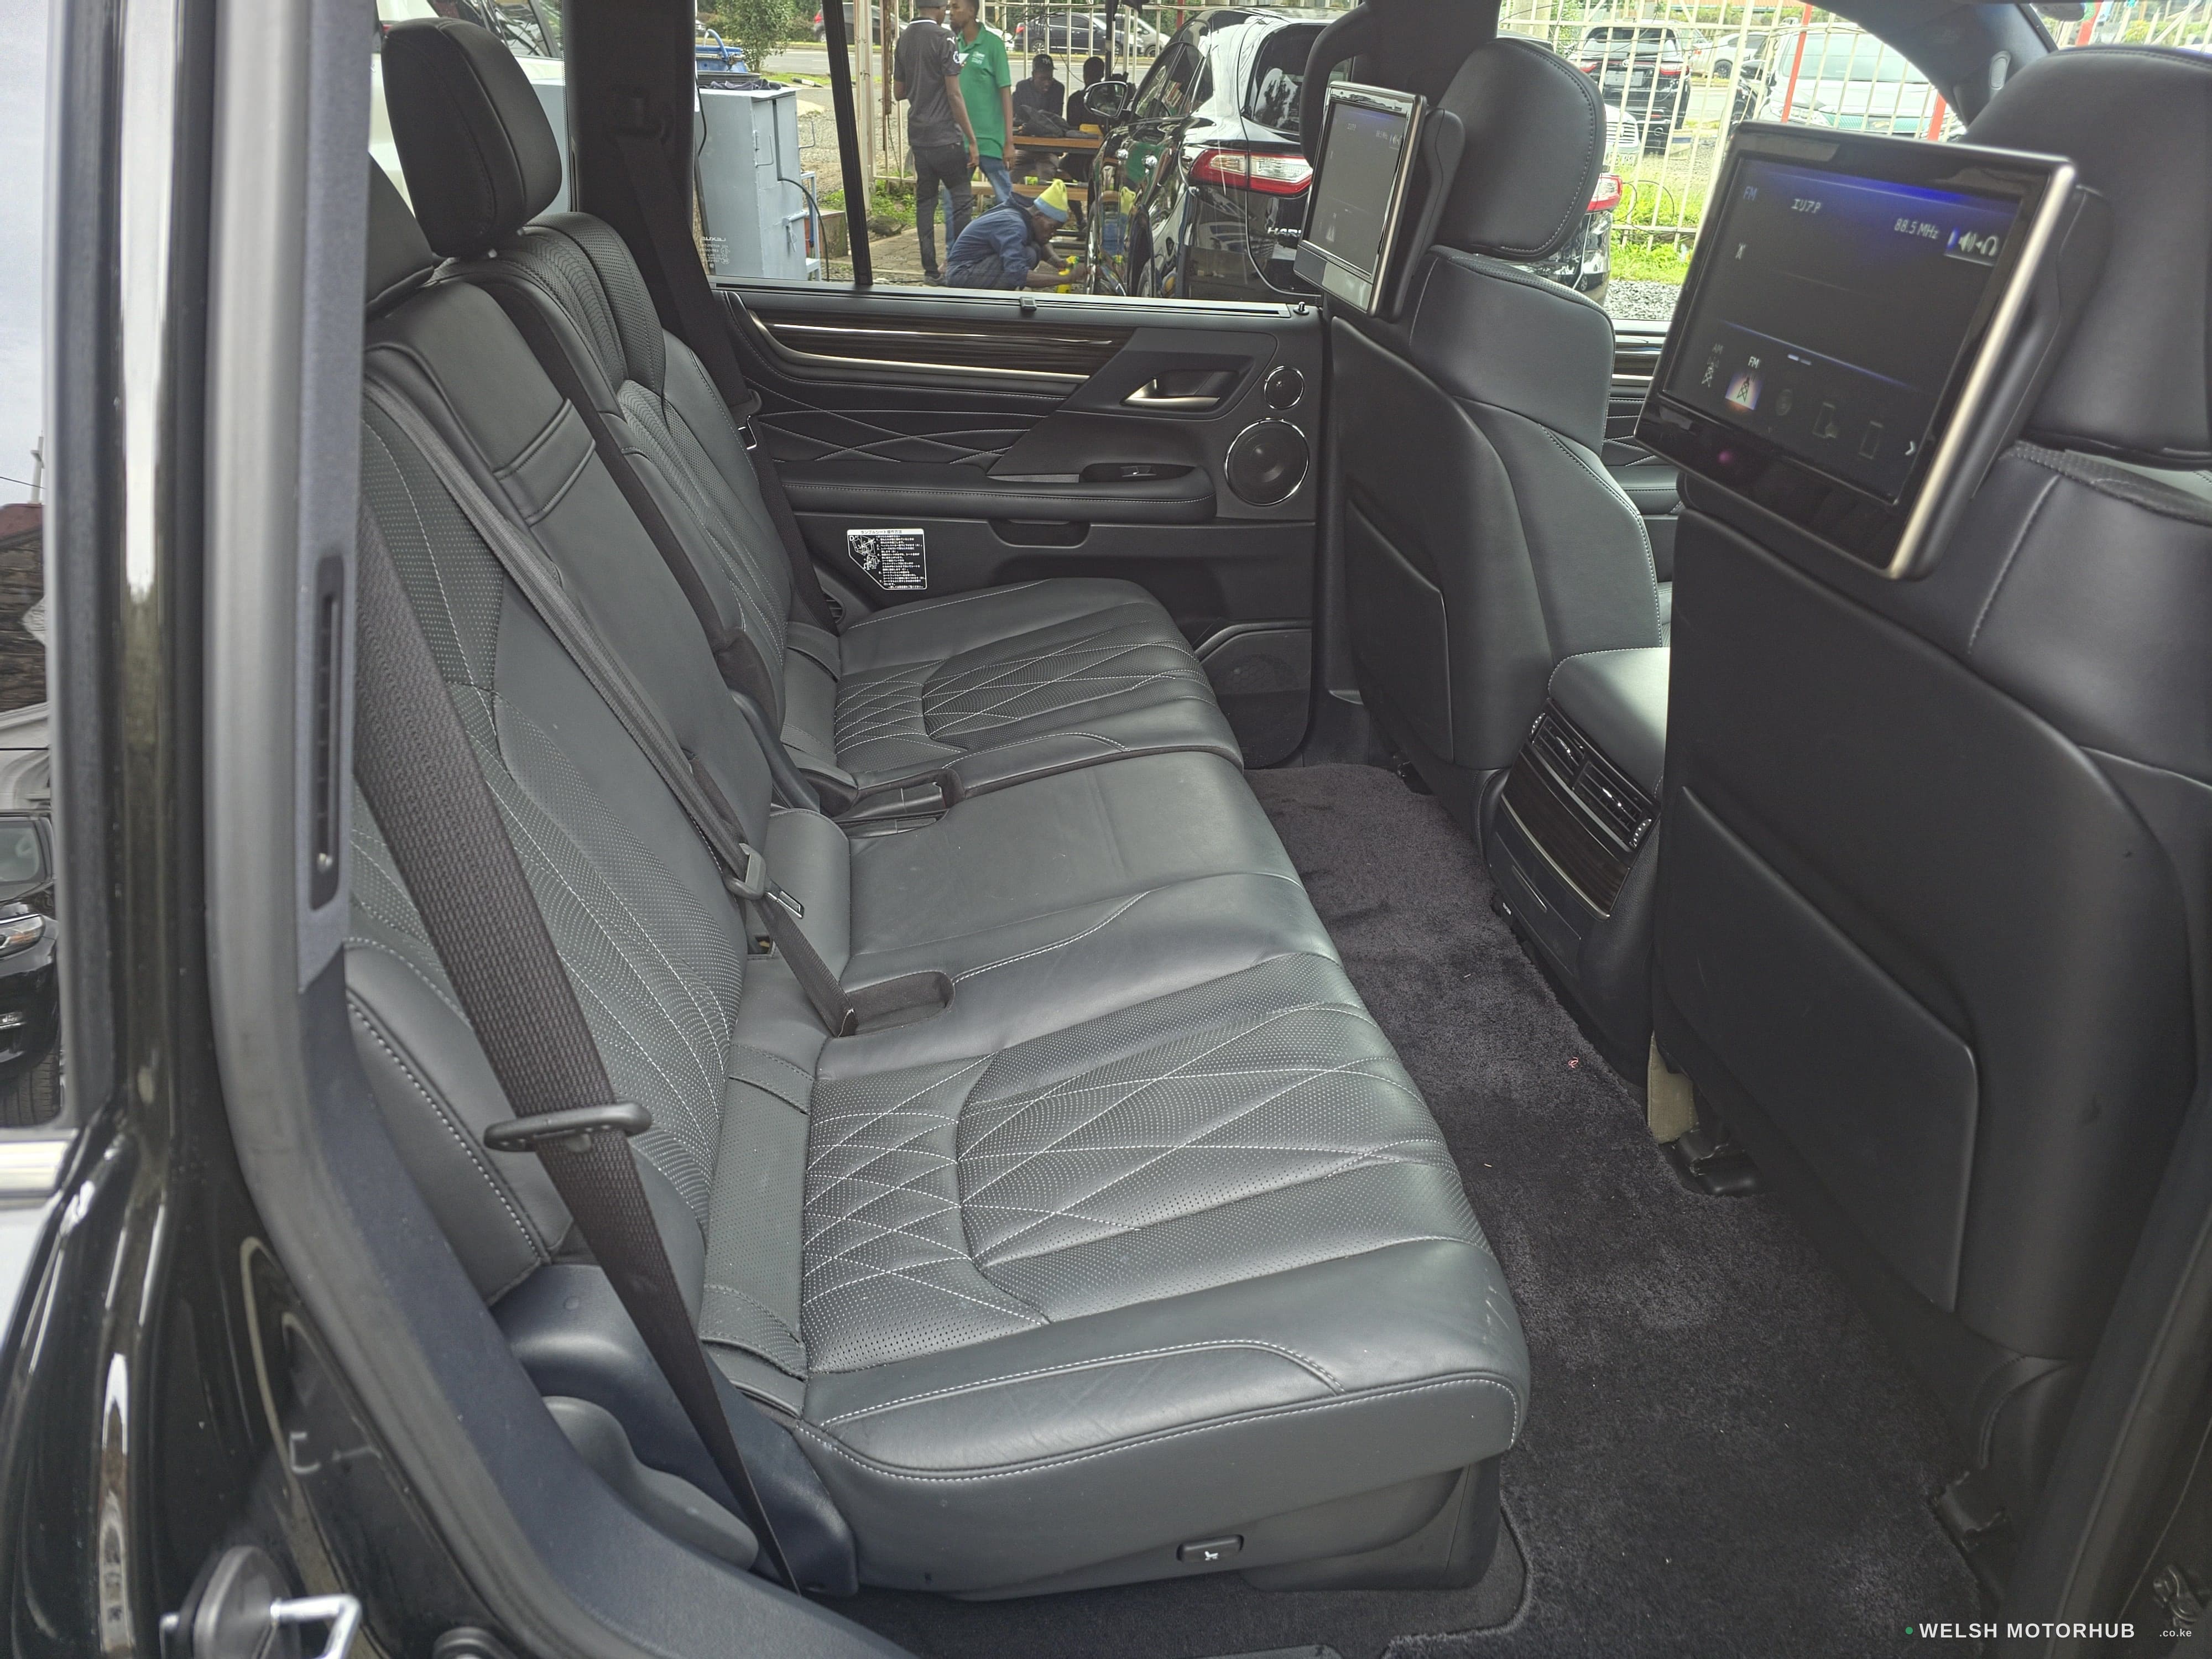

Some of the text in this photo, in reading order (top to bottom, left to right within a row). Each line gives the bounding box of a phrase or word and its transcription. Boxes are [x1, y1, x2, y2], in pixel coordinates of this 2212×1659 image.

[1743, 186, 1757, 201] FM
[1895, 218, 1938, 239] 88.5 MHz
[1748, 356, 1760, 369] FM
